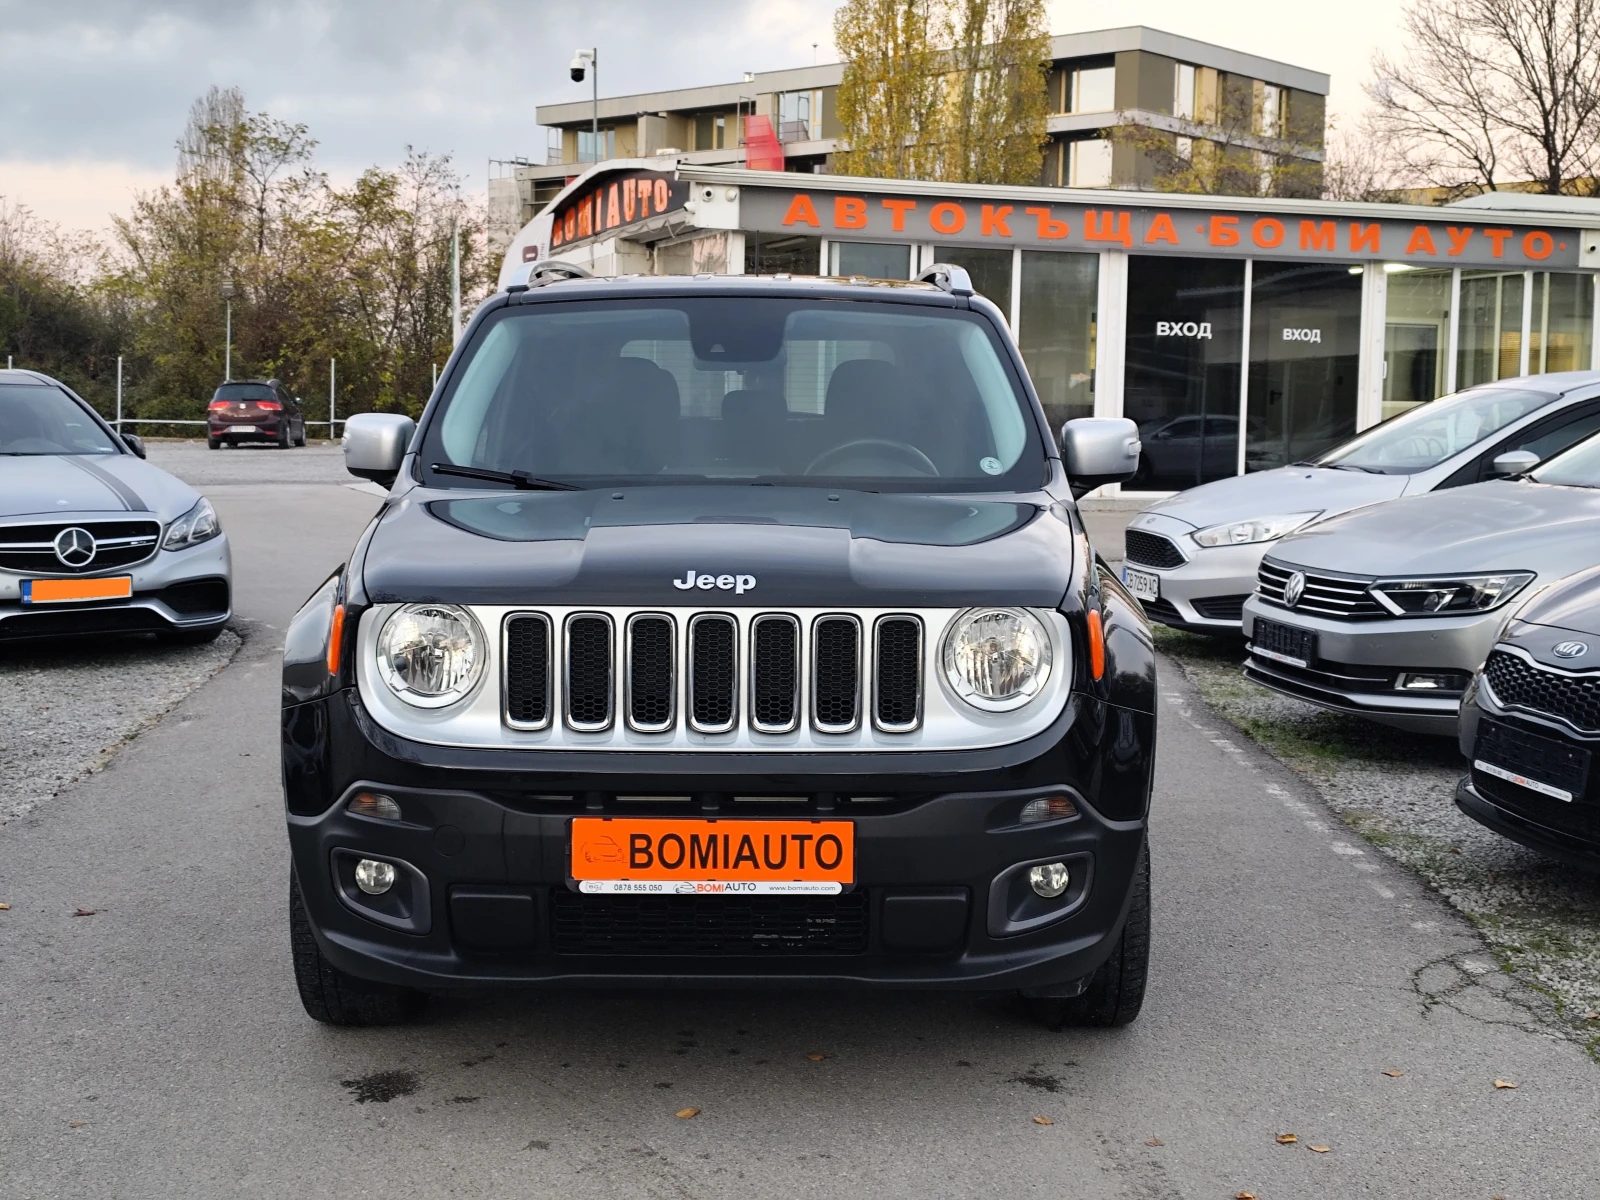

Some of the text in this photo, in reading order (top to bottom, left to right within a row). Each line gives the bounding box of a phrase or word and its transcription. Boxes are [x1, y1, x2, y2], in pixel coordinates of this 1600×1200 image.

[552, 178, 668, 247] BOMIAUTO
[782, 194, 1554, 260] АВТОКЪЩА БОМИ АУТО
[1156, 321, 1212, 339] ВХОД
[1282, 328, 1322, 343] ВХОД
[673, 570, 756, 595] Jeep
[629, 833, 844, 871] BOMIAUTO
